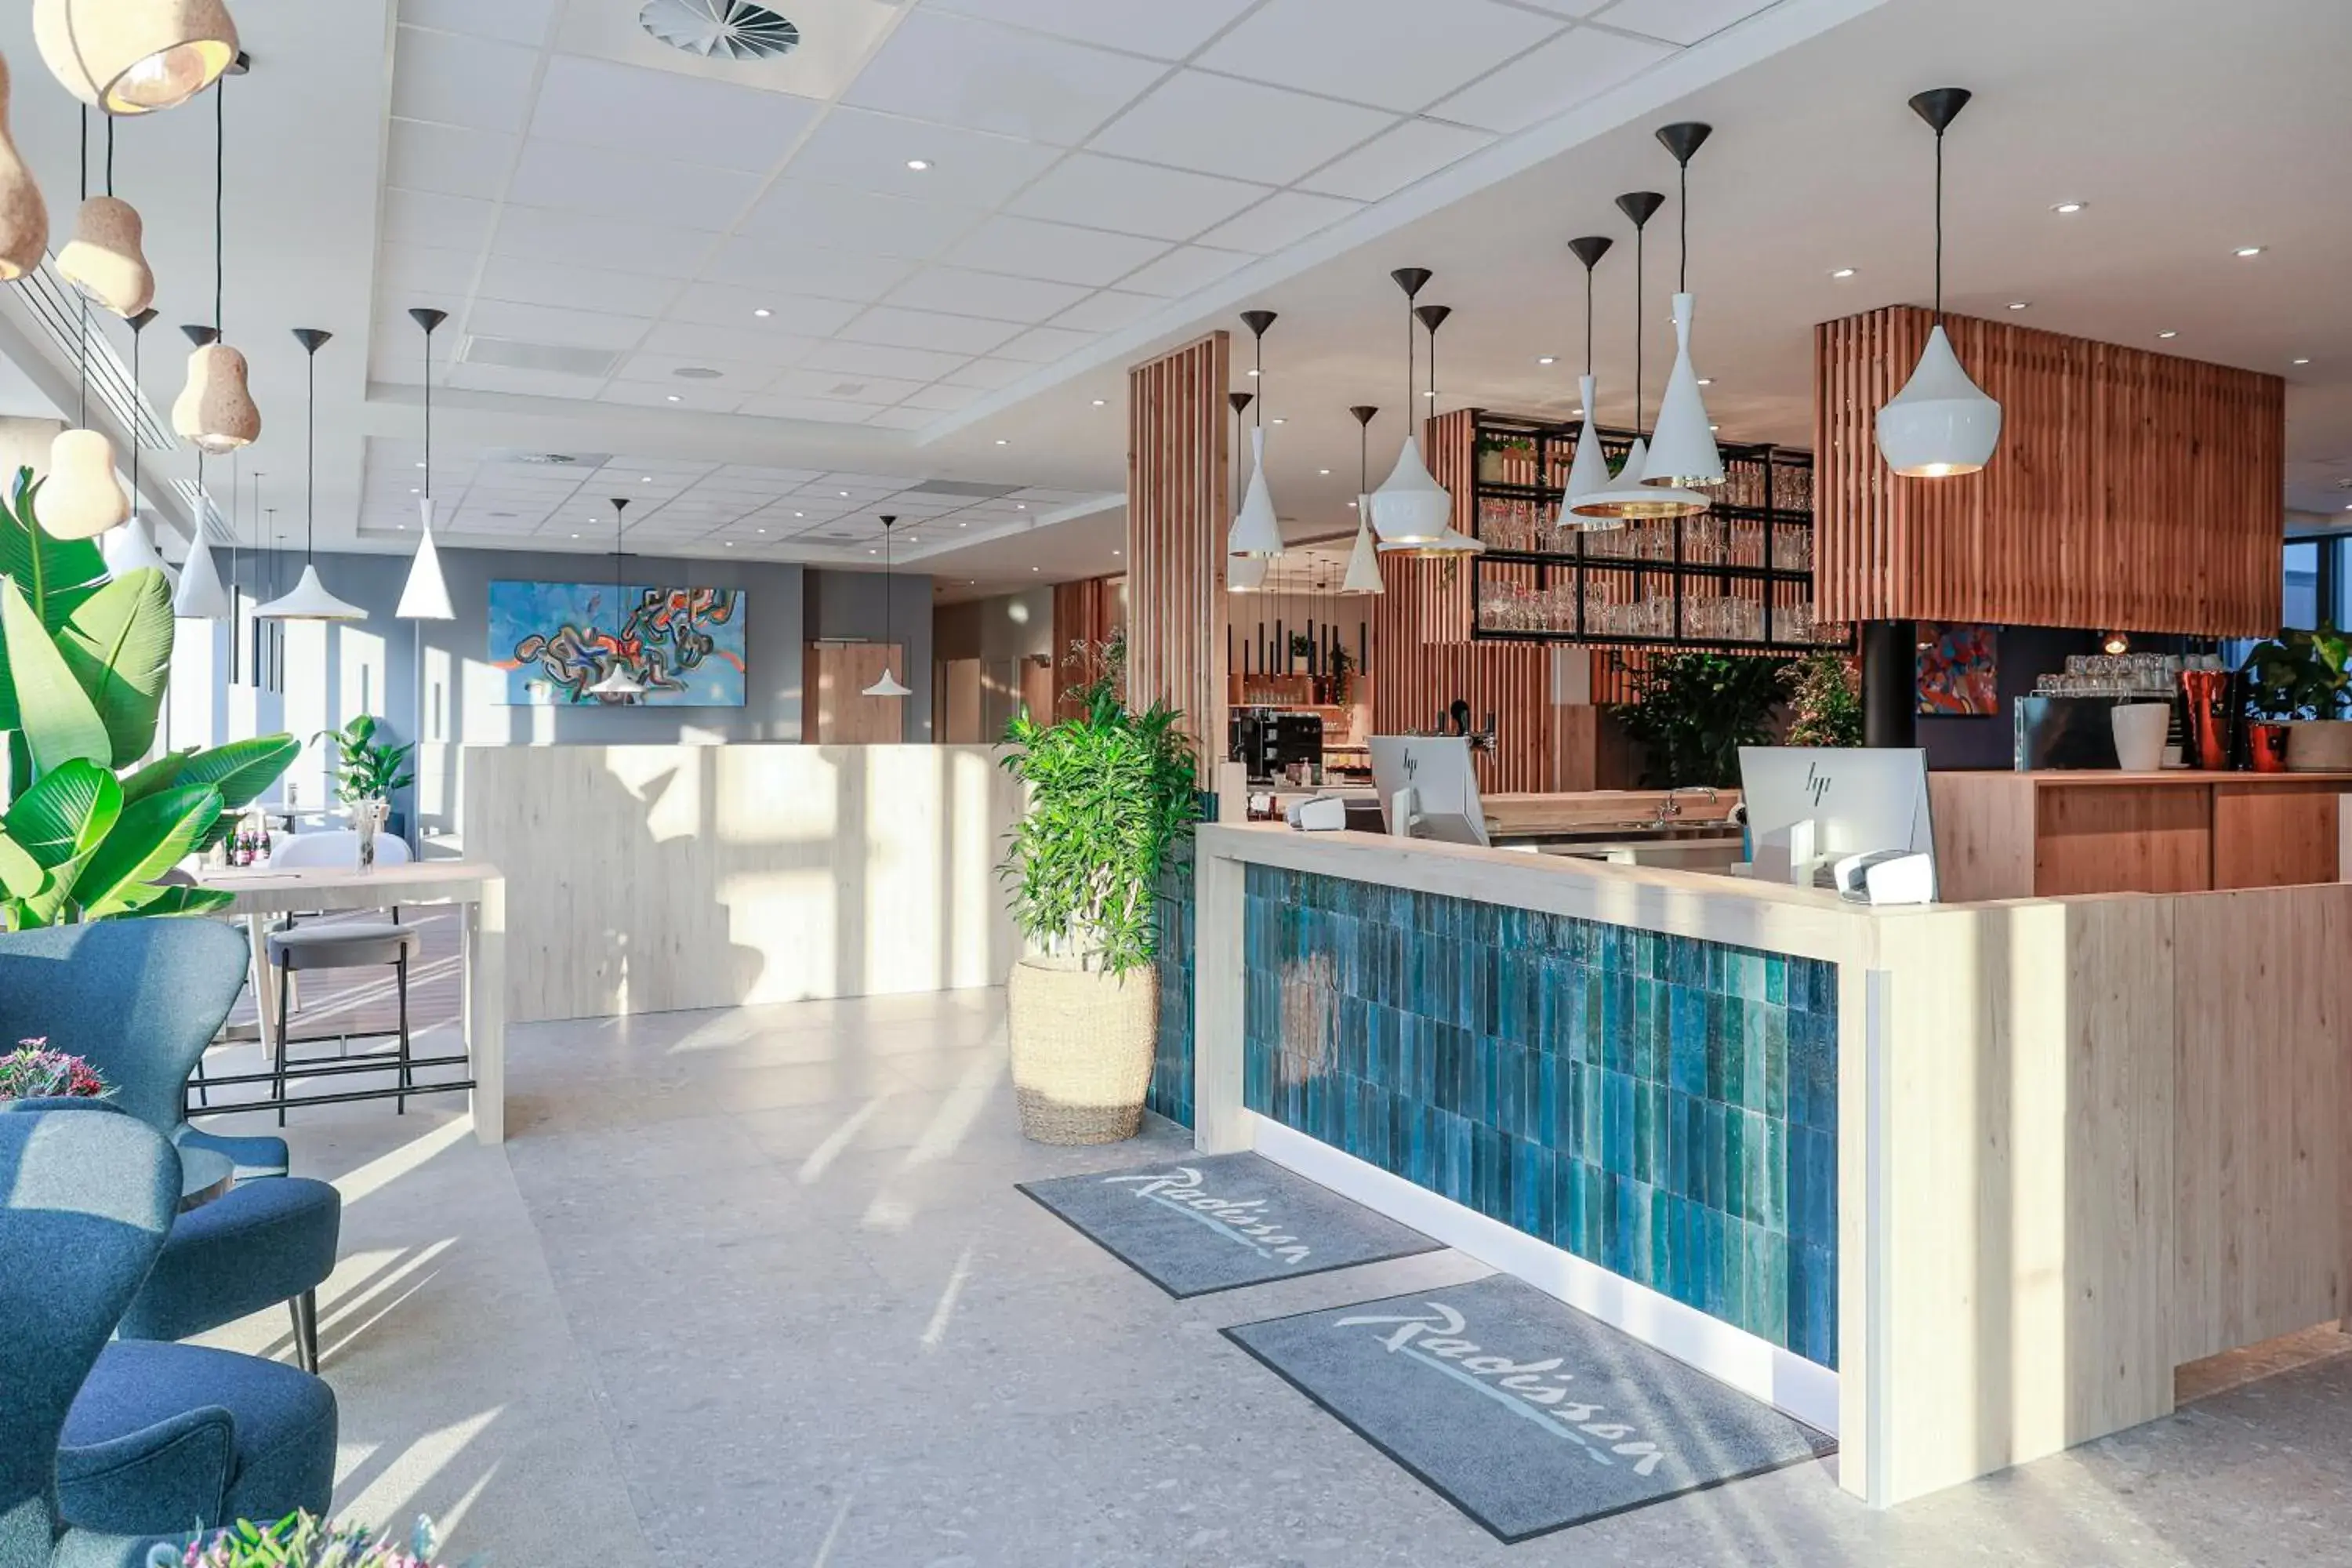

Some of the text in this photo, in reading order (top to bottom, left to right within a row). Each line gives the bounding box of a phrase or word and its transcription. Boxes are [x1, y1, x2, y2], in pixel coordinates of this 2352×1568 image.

[1403, 747, 1417, 780] hp
[1806, 761, 1831, 807] hp
[1100, 1166, 1311, 1265] Radisson
[1334, 1301, 1664, 1476] Radisson
